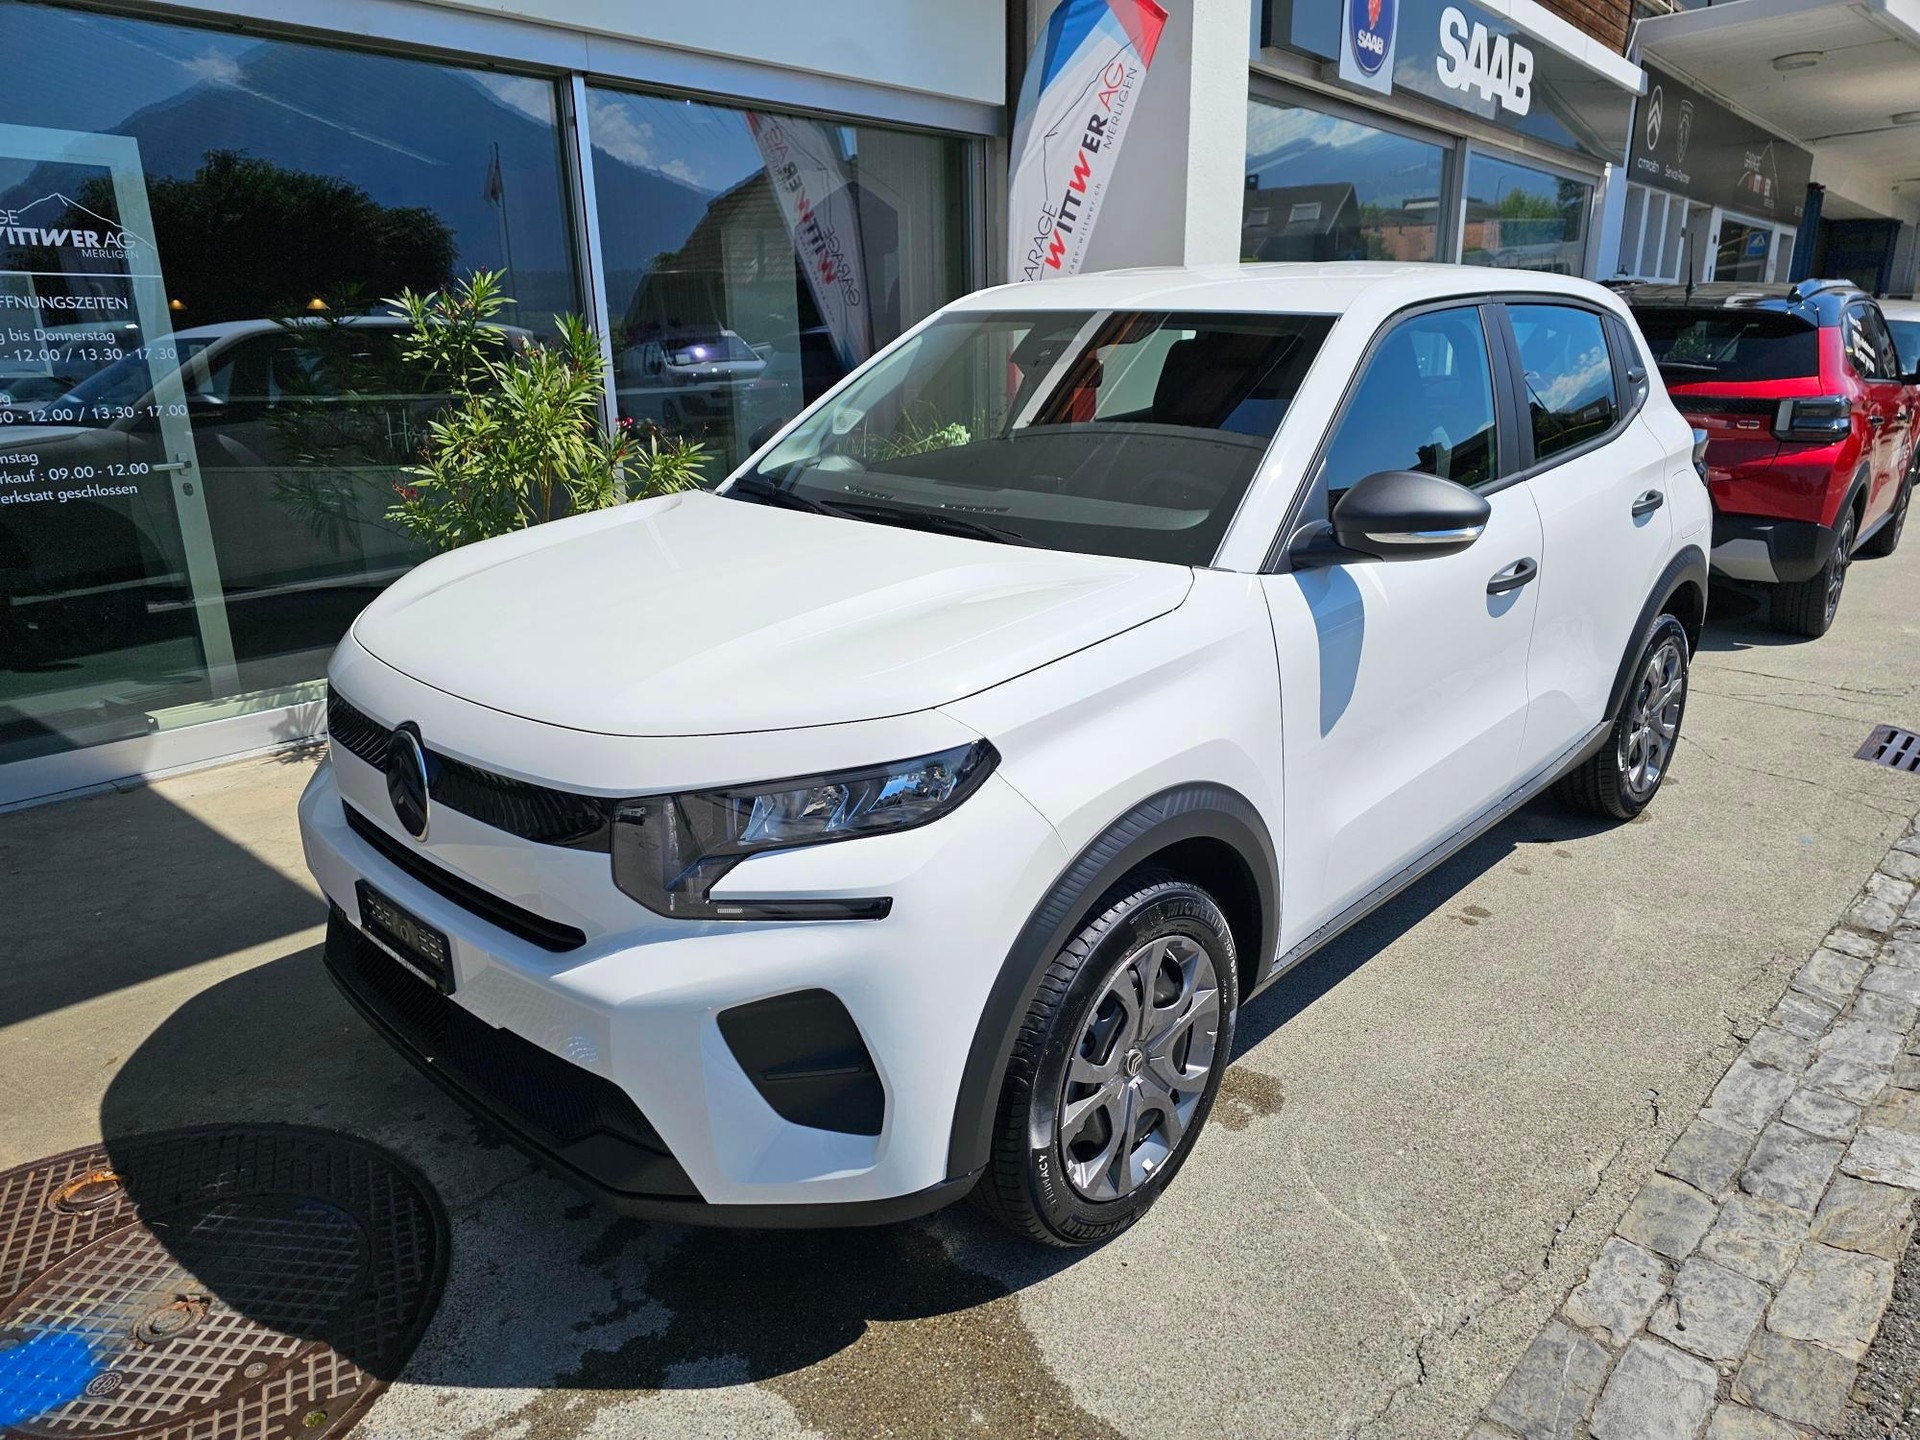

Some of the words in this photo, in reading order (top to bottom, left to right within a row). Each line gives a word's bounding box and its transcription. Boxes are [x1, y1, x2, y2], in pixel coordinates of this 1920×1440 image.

[1357, 29, 1384, 56] SAAB
[1436, 6, 1534, 117] SAAB
[1103, 67, 1137, 150] MERLIGEN
[1044, 113, 1108, 271] WITTWER
[1098, 62, 1124, 112] AG
[0, 226, 102, 248] ITTWER
[104, 231, 136, 249] AG
[1019, 201, 1057, 283] ARAGE
[81, 249, 138, 259] MERLIGEN
[9, 328, 31, 342] bis
[34, 328, 116, 345] Donnerstag
[14, 349, 60, 362] 12.00
[79, 348, 123, 361] 13.30
[28, 408, 73, 422] 12.00
[92, 405, 134, 419] 13.30
[146, 404, 188, 417] 17.00
[48, 466, 94, 481] 09.00
[107, 462, 149, 477] 12.00
[58, 484, 138, 503] geschlossen
